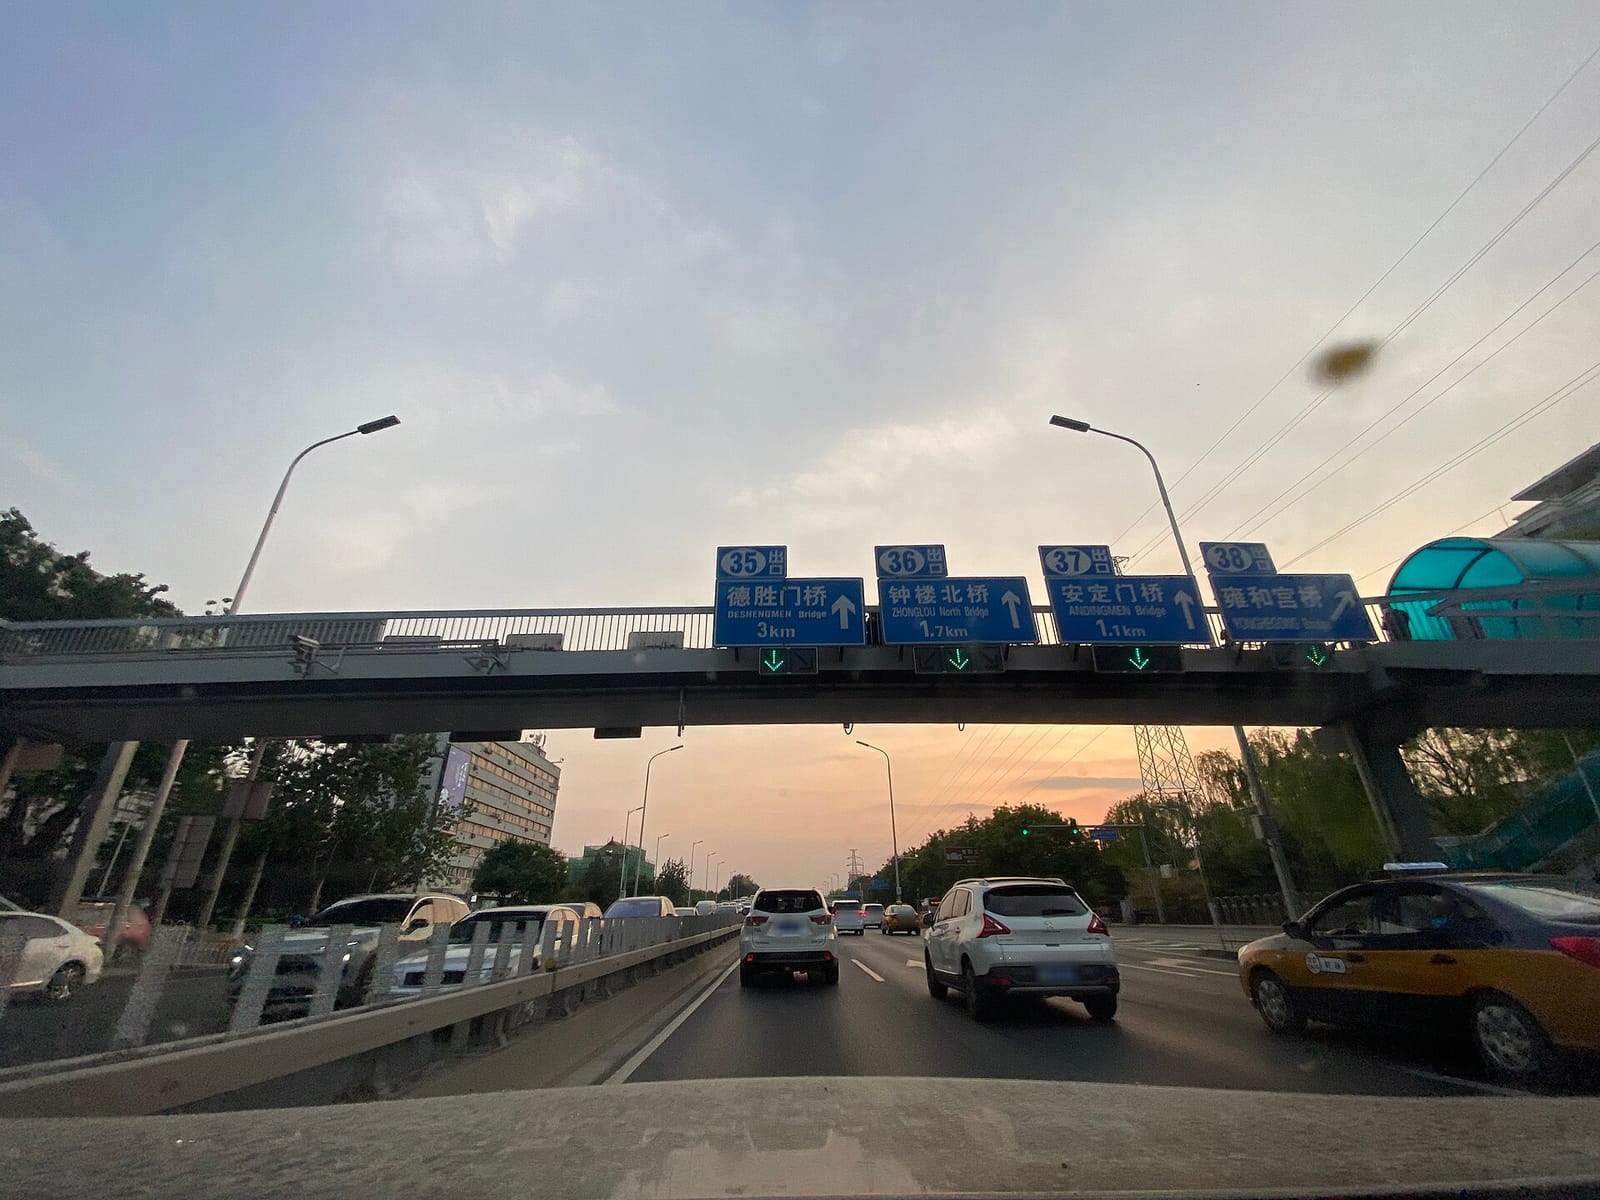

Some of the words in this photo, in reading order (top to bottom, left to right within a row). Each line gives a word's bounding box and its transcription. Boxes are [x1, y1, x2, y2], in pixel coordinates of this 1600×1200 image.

[730, 551, 758, 573] 35
[769, 550, 784, 575] 出口
[889, 550, 917, 572] 36
[928, 549, 943, 574] 出口
[1054, 551, 1082, 573] 37
[1091, 549, 1110, 574] 出口
[1216, 548, 1245, 570] 38
[727, 585, 827, 607] 德胜门桥
[888, 584, 989, 605] 钟楼北桥
[1061, 584, 1164, 603] 安定门桥
[799, 610, 827, 619] Bridge
[891, 606, 936, 617] ZHONGLOU
[940, 606, 961, 617] North
[965, 607, 989, 617] Bridge
[1068, 605, 1131, 616] ANDINGMEN
[1135, 606, 1167, 617] Bridge
[757, 622, 796, 638] 3km
[919, 620, 968, 638] 1.7km
[1096, 619, 1146, 638] 1.1km
